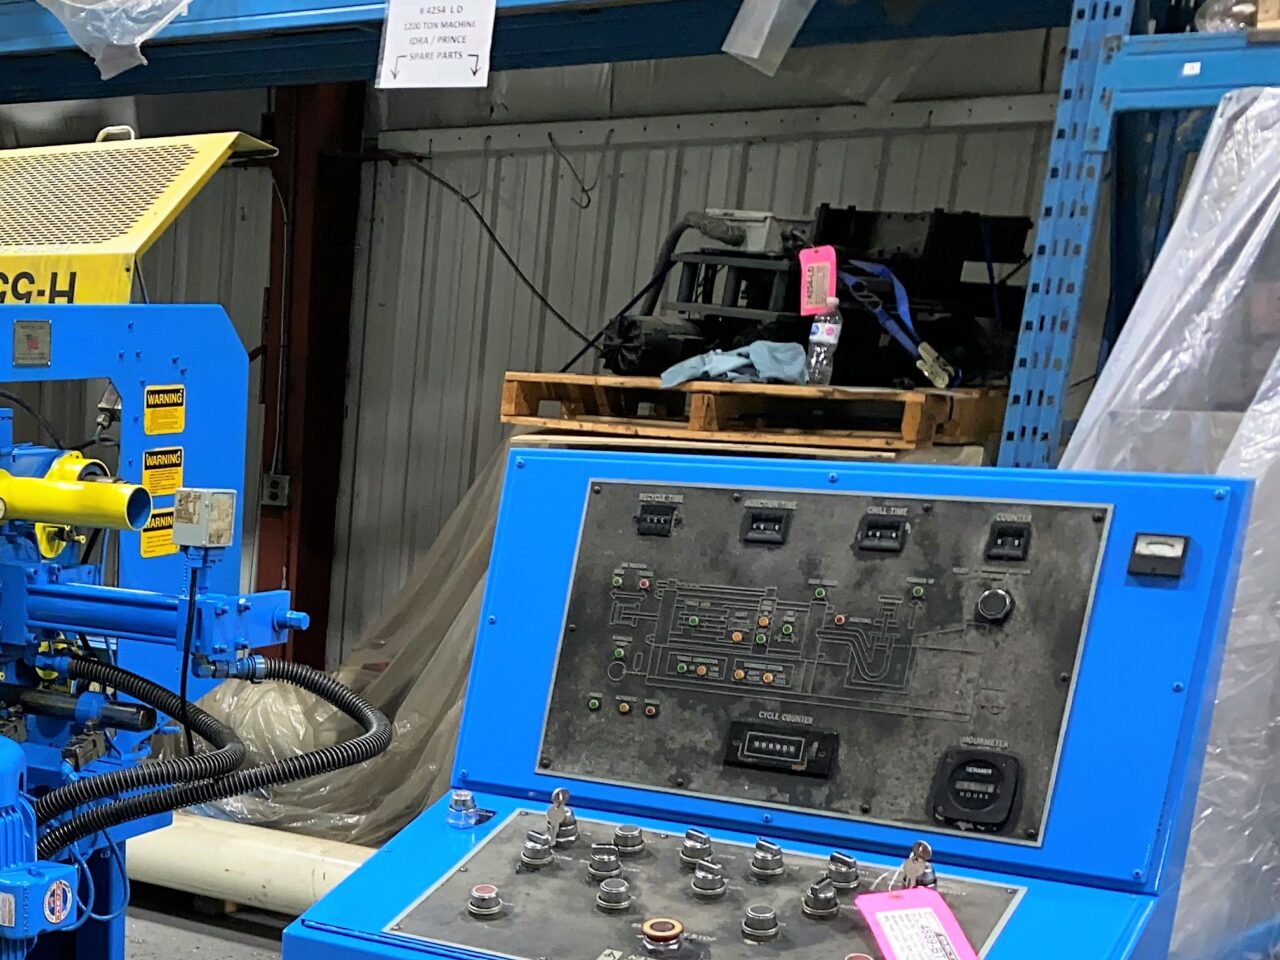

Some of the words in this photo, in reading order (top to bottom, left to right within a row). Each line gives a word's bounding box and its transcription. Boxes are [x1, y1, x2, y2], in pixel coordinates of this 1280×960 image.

[440, 21, 476, 29] MACHINE
[437, 35, 467, 44] PRINCE
[409, 52, 435, 61] SPARE
[436, 51, 463, 60] PARTS
[147, 391, 183, 406] WARNING
[145, 452, 181, 467] WARNING
[867, 506, 887, 515] CHILL
[889, 507, 909, 516] TIME
[144, 515, 174, 530] ARNIN
[996, 513, 1032, 522] COUNTER
[758, 710, 779, 721] CYCLE
[781, 713, 814, 725] COUNTER
[962, 736, 1009, 748] HOURMETER
